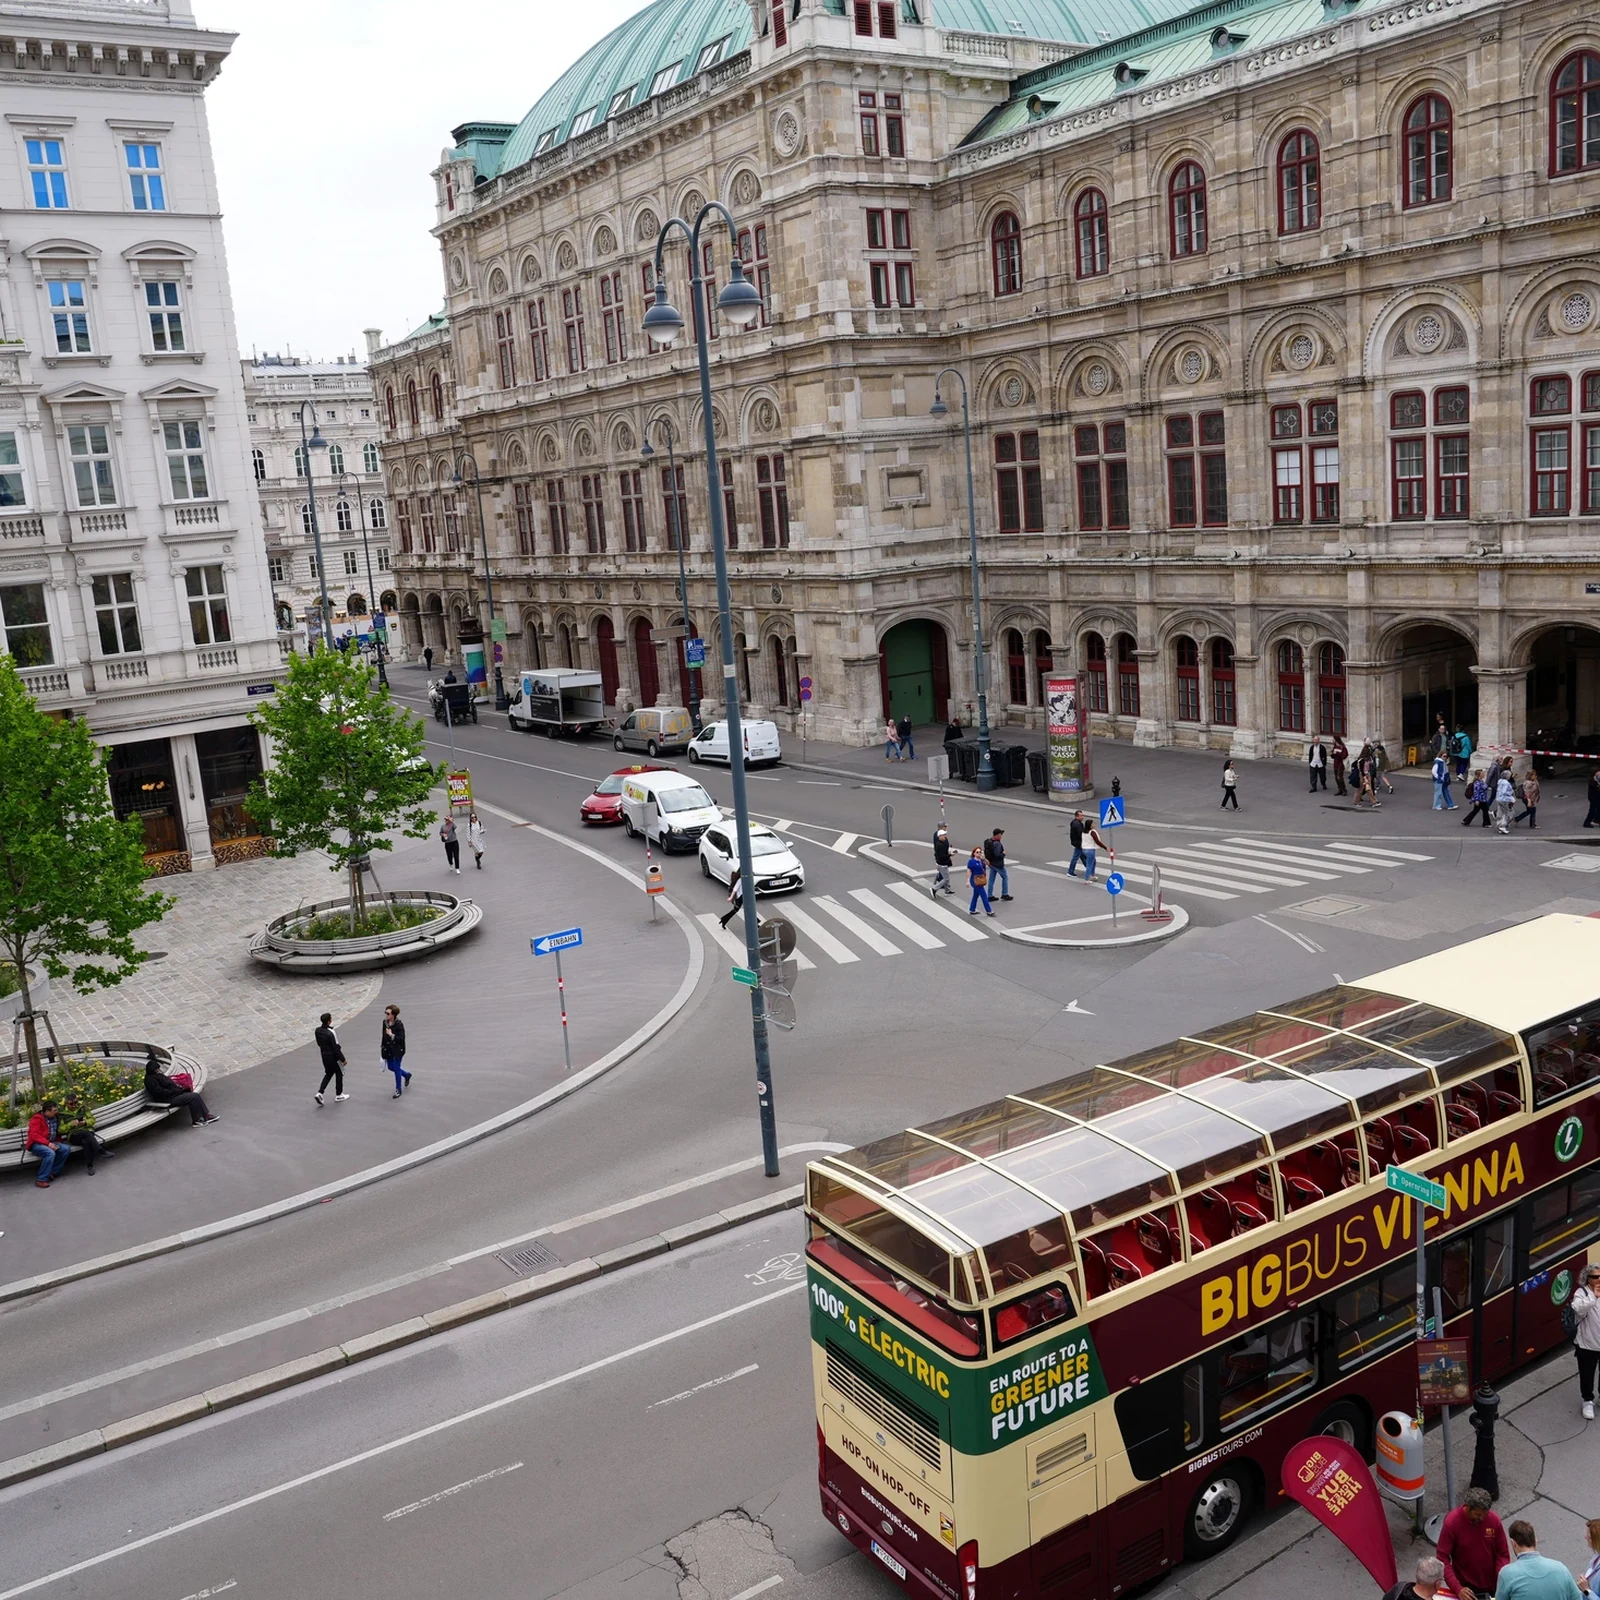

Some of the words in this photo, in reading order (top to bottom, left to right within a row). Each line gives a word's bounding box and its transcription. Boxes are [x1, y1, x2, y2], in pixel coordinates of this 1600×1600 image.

[549, 934, 577, 948] EINBAHN
[1401, 1176, 1430, 1197] Opernring
[811, 1282, 857, 1333] 100%
[858, 1315, 950, 1399] ELECTRIC
[989, 1373, 1009, 1394] EN
[1012, 1351, 1057, 1384] ROUTE
[1059, 1343, 1076, 1361] TO
[1079, 1338, 1089, 1353] A
[1439, 1356, 1446, 1369] 1
[990, 1352, 1089, 1414] GREENER
[991, 1372, 1090, 1440] FUTURE
[841, 1434, 880, 1477] HOP-ON
[881, 1469, 931, 1516] HOP-OFF
